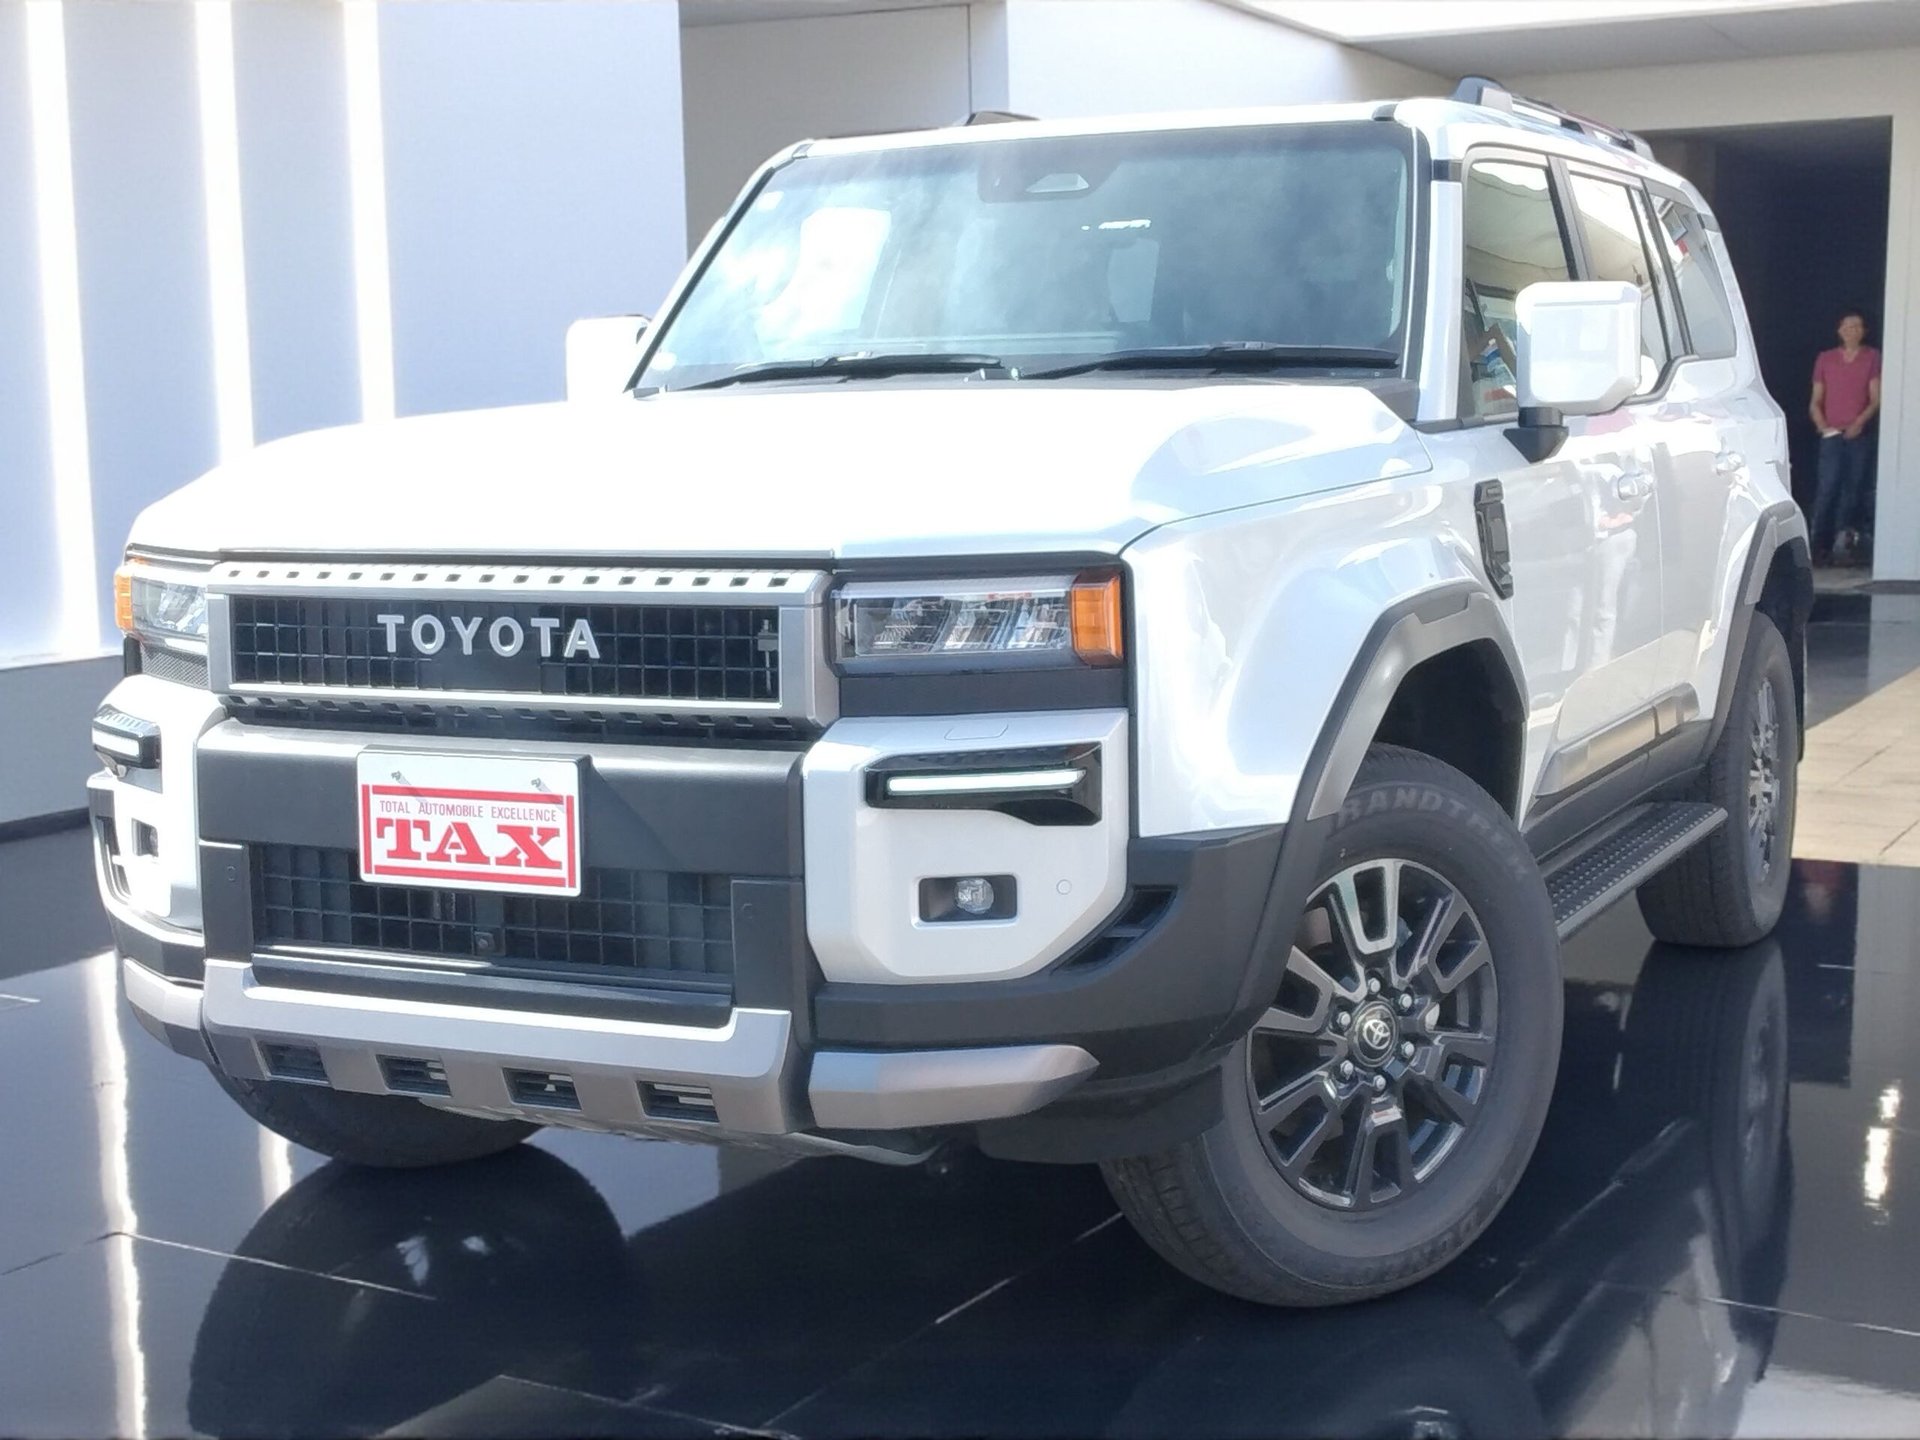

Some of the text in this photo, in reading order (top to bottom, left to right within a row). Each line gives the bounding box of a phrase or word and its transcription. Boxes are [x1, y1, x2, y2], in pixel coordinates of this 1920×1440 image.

[377, 614, 600, 659] TOYOTA
[379, 800, 557, 822] TOTAL AUTOMOBILE EXCELLENCE
[376, 817, 563, 870] TAX
